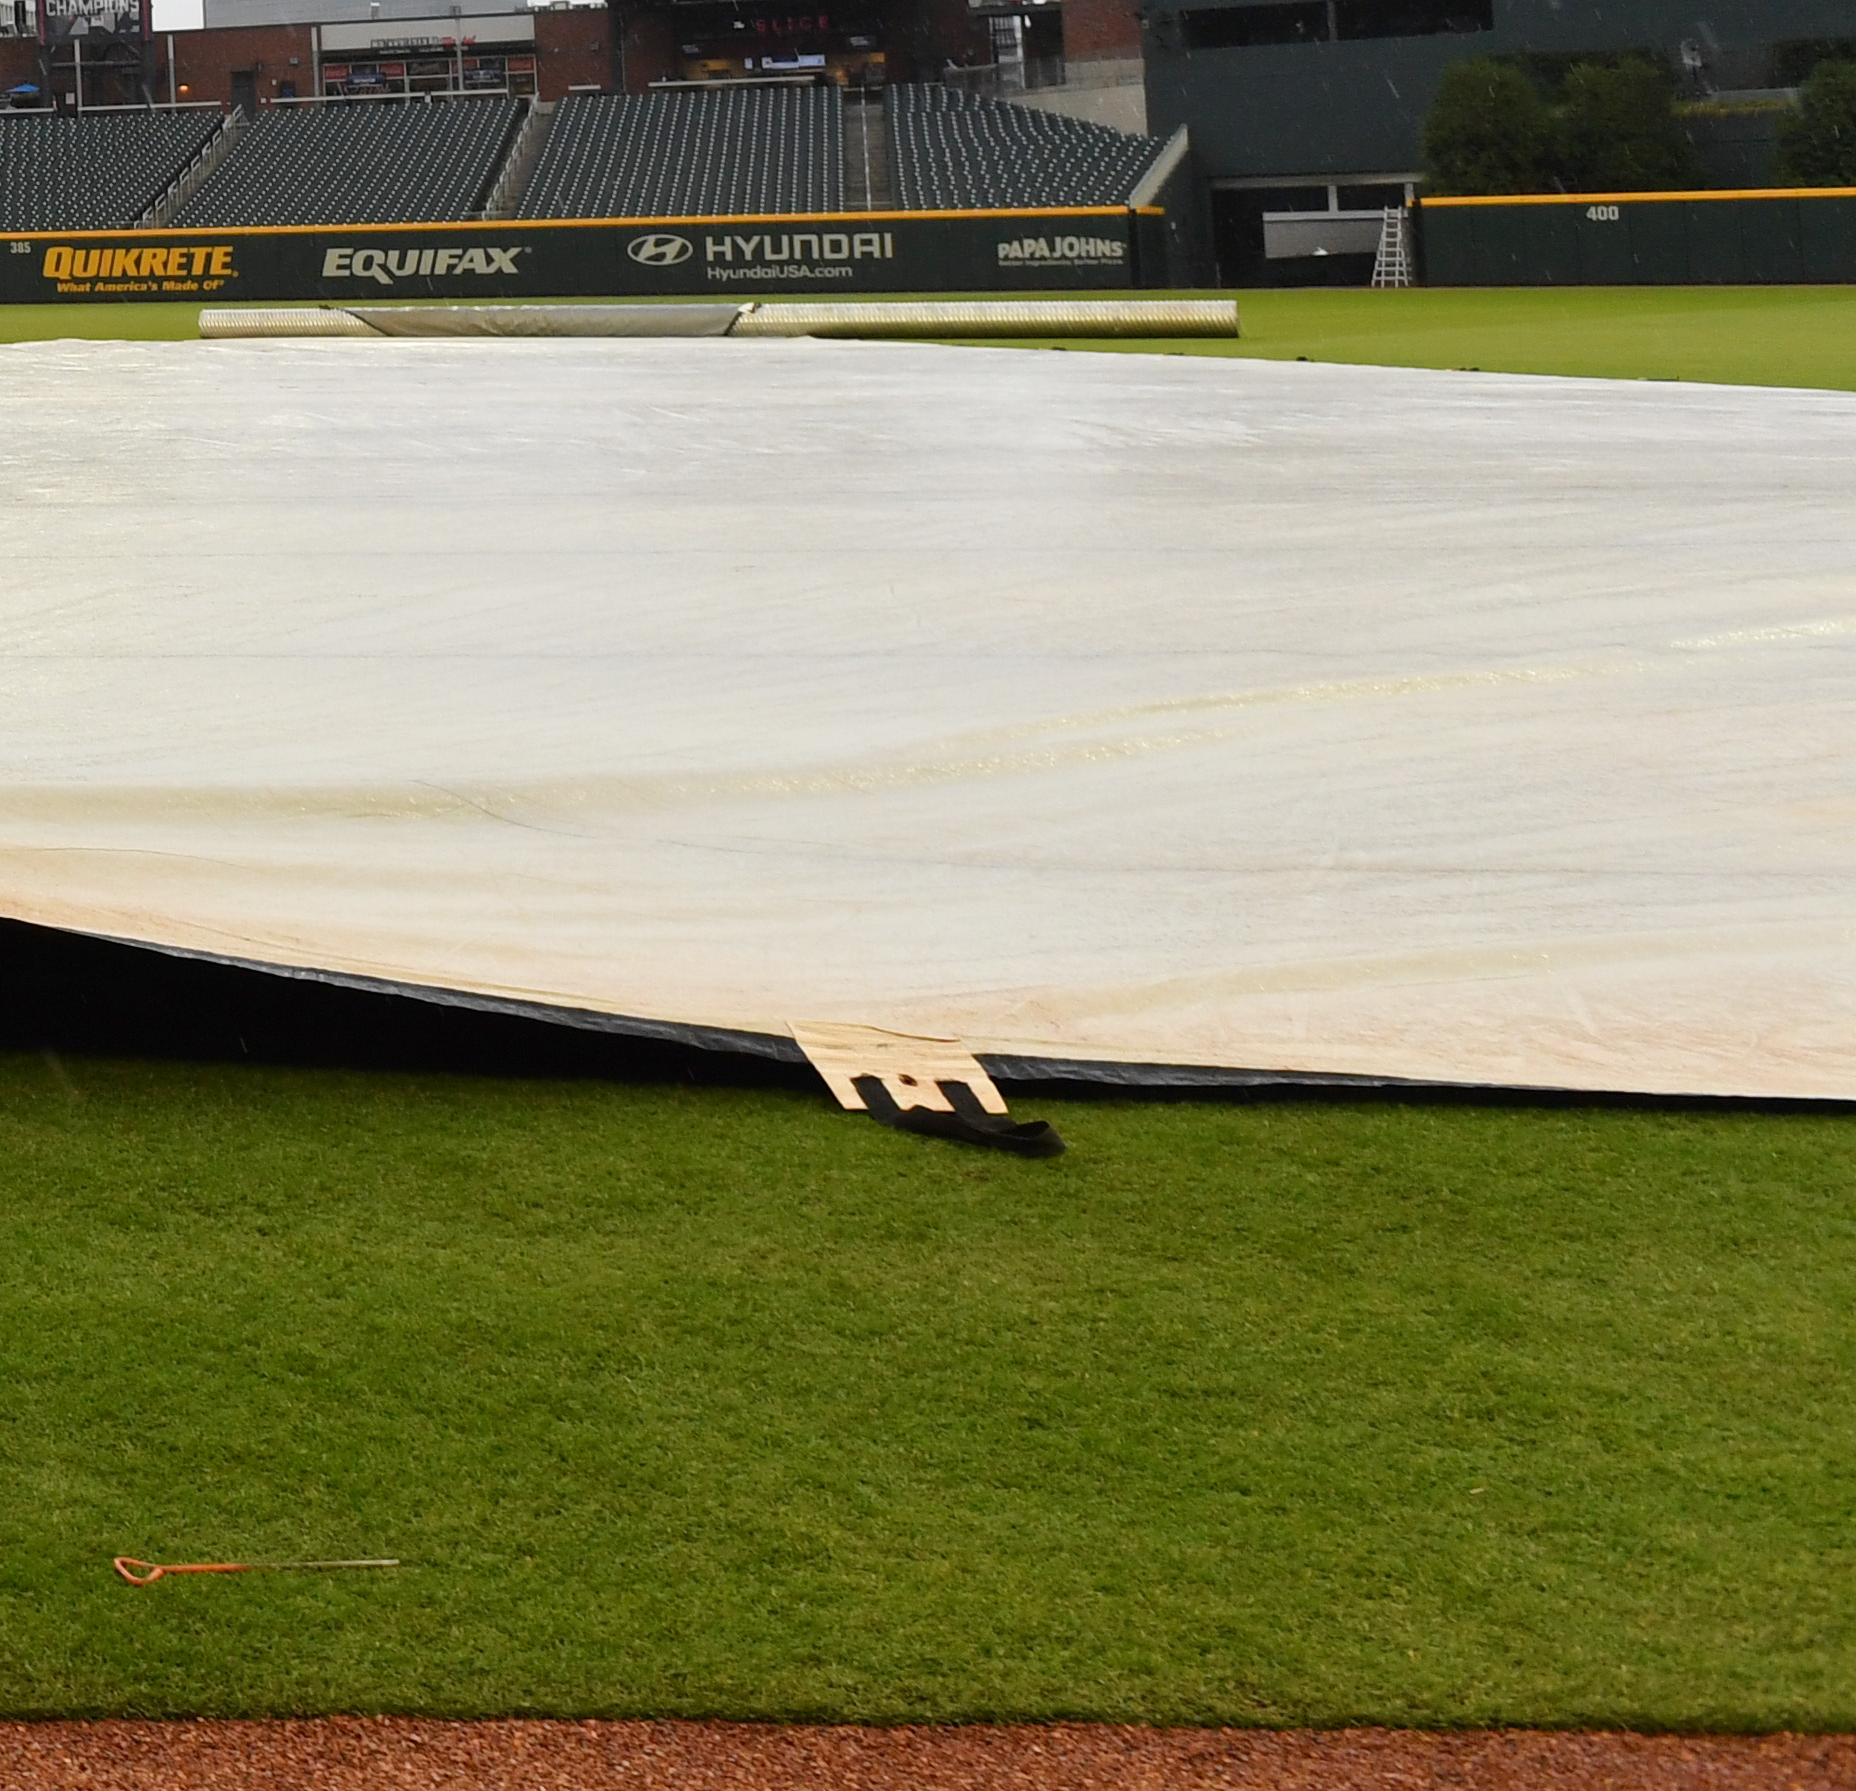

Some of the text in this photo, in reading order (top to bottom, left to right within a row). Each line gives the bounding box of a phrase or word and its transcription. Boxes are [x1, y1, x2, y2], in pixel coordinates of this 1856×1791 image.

[1585, 205, 1619, 221] 400
[10, 242, 31, 254] 385
[705, 232, 893, 261] HYUNDAI
[997, 237, 1050, 259] PAPA
[43, 246, 234, 280] QUIKRETE
[321, 247, 524, 284] EQUIFAX
[707, 263, 853, 282] HyundaiUSA.com
[57, 279, 219, 292] What America's Made Of
